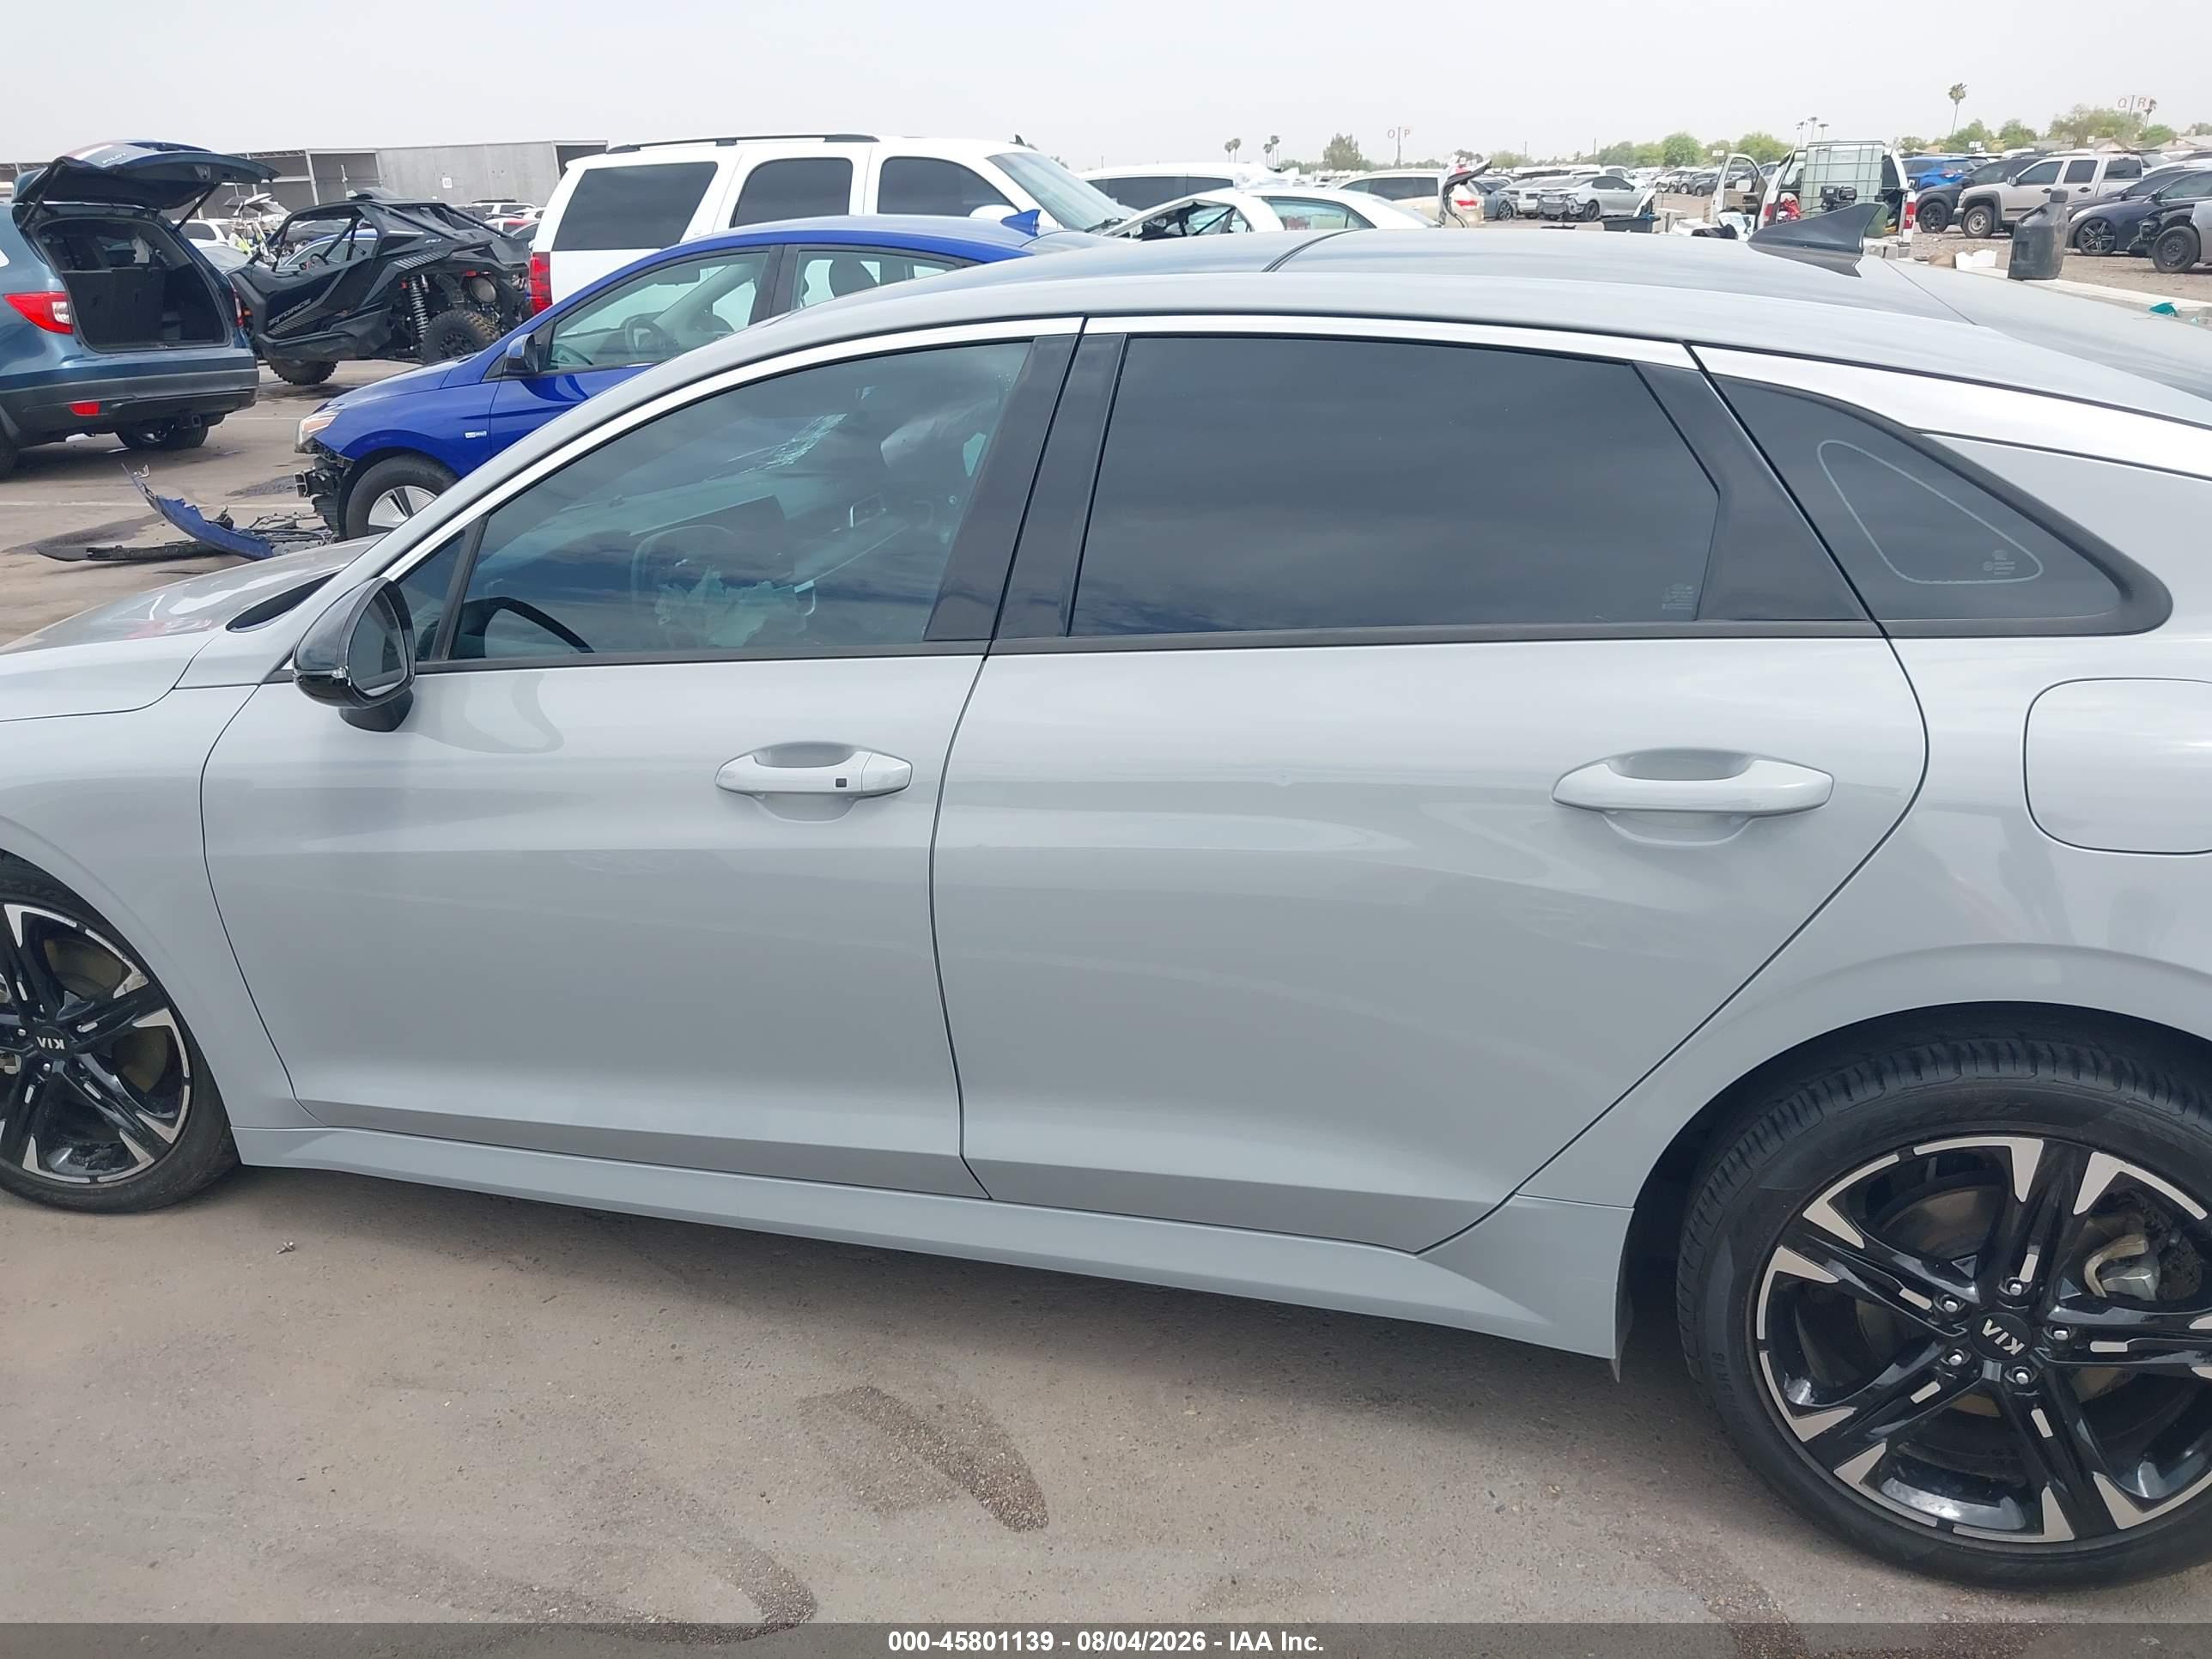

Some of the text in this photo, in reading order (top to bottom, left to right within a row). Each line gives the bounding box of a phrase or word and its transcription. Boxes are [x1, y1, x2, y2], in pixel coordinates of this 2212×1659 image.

[2137, 97, 2147, 108] R
[1404, 129, 1411, 138] P
[36, 1036, 66, 1050] KIA
[1982, 1318, 2026, 1356] KIA
